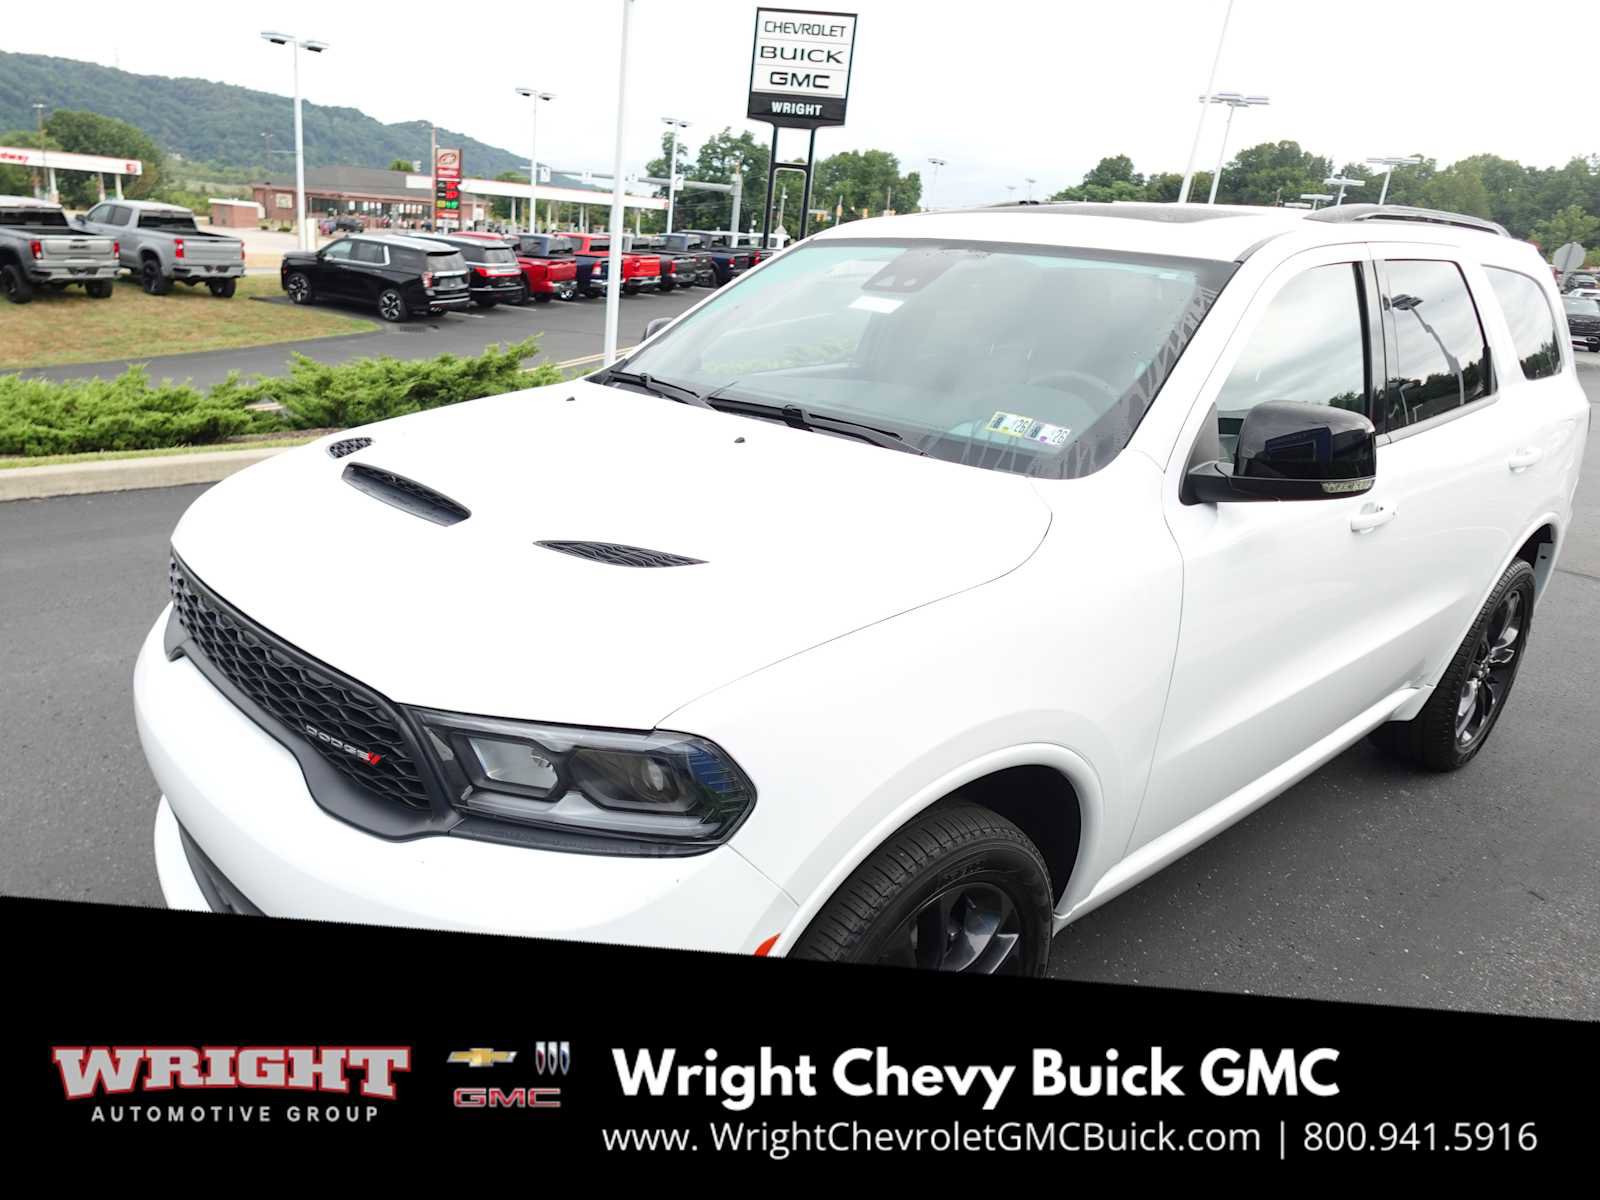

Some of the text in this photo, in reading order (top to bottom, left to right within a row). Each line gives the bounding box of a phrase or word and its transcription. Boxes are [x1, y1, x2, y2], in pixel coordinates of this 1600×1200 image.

[764, 20, 847, 38] CHEVROLET
[760, 45, 844, 64] BUICK
[769, 71, 830, 89] GMC
[771, 101, 823, 116] WRIGHT
[306, 724, 371, 761] DODGE
